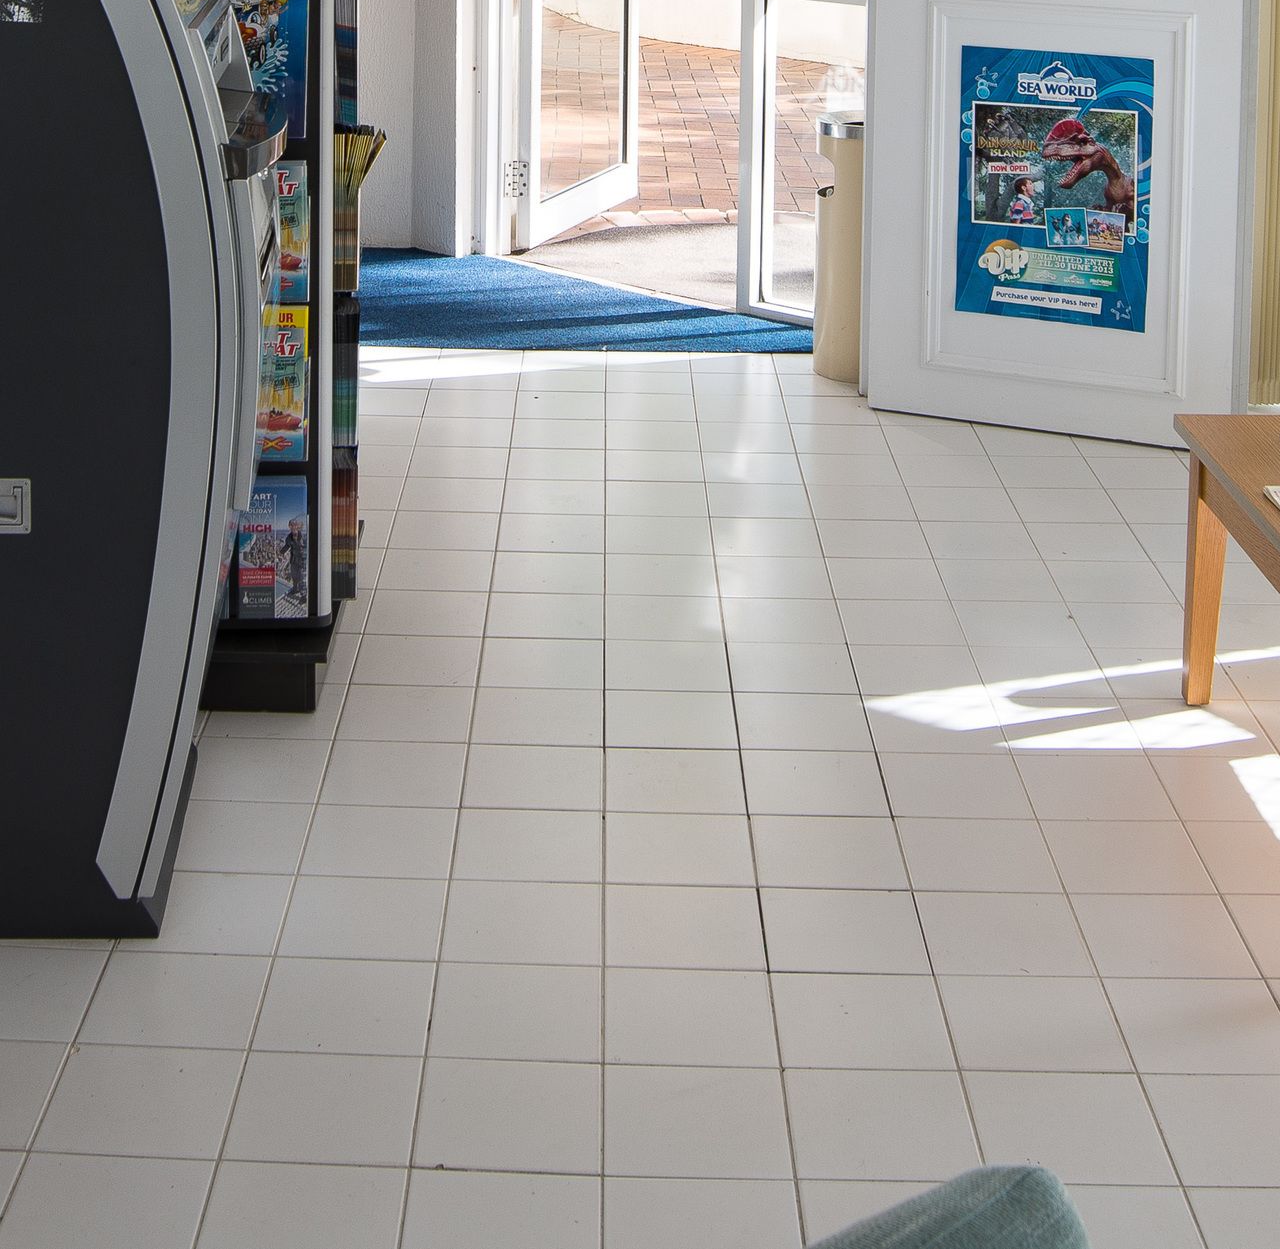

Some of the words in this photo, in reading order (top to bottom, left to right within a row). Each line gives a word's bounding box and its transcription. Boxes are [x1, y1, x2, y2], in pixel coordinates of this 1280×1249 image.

[1019, 80, 1043, 94] SEA
[1044, 82, 1095, 98] WORLD
[1010, 164, 1029, 173] OPEN
[1032, 252, 1083, 265] UNLIMITED
[1084, 257, 1115, 268] ENTRY
[1054, 261, 1066, 269] 30
[1068, 260, 1091, 271] JUNE
[1092, 264, 1114, 274] 2013
[995, 290, 1029, 301] Purchase
[1030, 294, 1047, 303] your
[1062, 297, 1077, 306] Pass
[1078, 299, 1098, 309] here!
